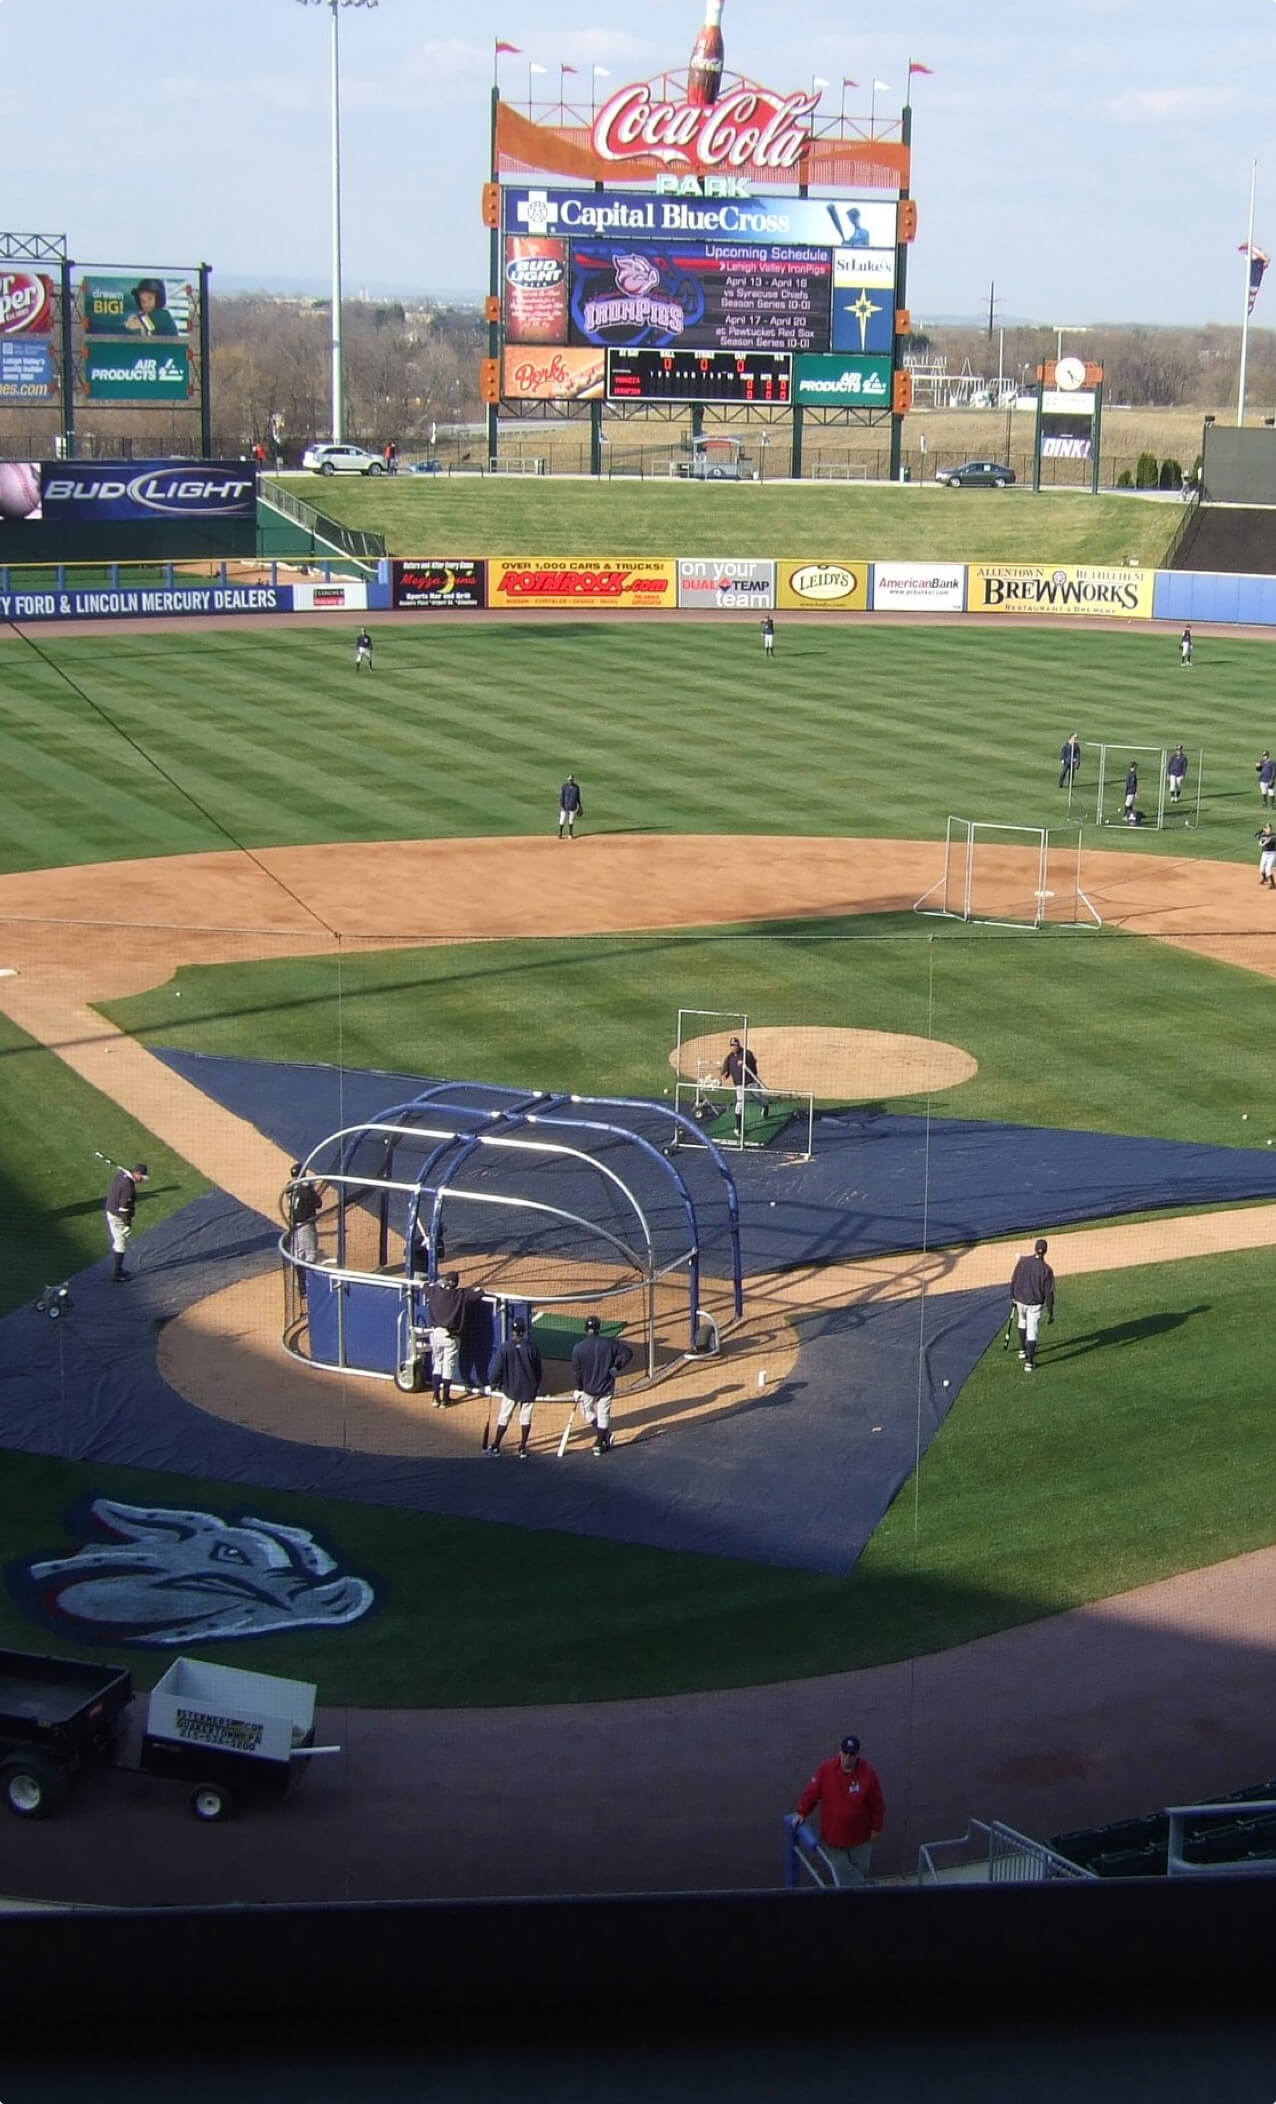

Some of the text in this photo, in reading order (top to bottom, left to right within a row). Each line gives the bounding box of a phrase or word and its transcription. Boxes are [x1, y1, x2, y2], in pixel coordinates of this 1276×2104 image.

[656, 174, 752, 198] PARK
[560, 200, 791, 232] Capital BlueCross
[705, 245, 828, 261] Upcoming Schedule
[517, 260, 558, 271] BUD
[726, 261, 825, 276] Lehigh Valley IronPigs
[511, 269, 563, 281] LIGHT
[726, 276, 746, 287] April
[751, 277, 762, 287] 13
[770, 277, 792, 288] April
[92, 288, 124, 299] dream
[737, 288, 778, 299] Syracuse
[781, 289, 809, 300] Chiefs
[721, 298, 755, 309] Season
[758, 298, 785, 309] Series
[725, 315, 746, 326] April
[750, 316, 760, 325] 17
[770, 316, 791, 327] April
[715, 326, 815, 338] at Pawtucket Red Sox
[720, 336, 754, 346] Season
[756, 337, 785, 348] Series
[134, 359, 157, 370] AIR
[91, 369, 157, 381] PRODUCTS
[840, 371, 862, 383] AIR
[799, 380, 862, 393] PRODUCTS
[44, 479, 253, 499] BUD LIGHT
[501, 562, 531, 570] OVER
[535, 562, 567, 571] 1,000
[569, 562, 602, 570] CARS
[616, 563, 664, 571] TRUCKS!
[681, 562, 758, 581] on your
[976, 567, 1045, 577] ALLENTOWN
[682, 579, 770, 591] DUAL TEMP
[799, 572, 850, 591] LEIDY'S
[878, 576, 959, 590] AmericanBank
[16, 594, 55, 615] FORD
[60, 595, 71, 614] &
[76, 592, 138, 614] LINCOLN
[142, 591, 210, 613] MERCURY
[214, 589, 277, 609] DEALERS
[715, 591, 770, 608] team
